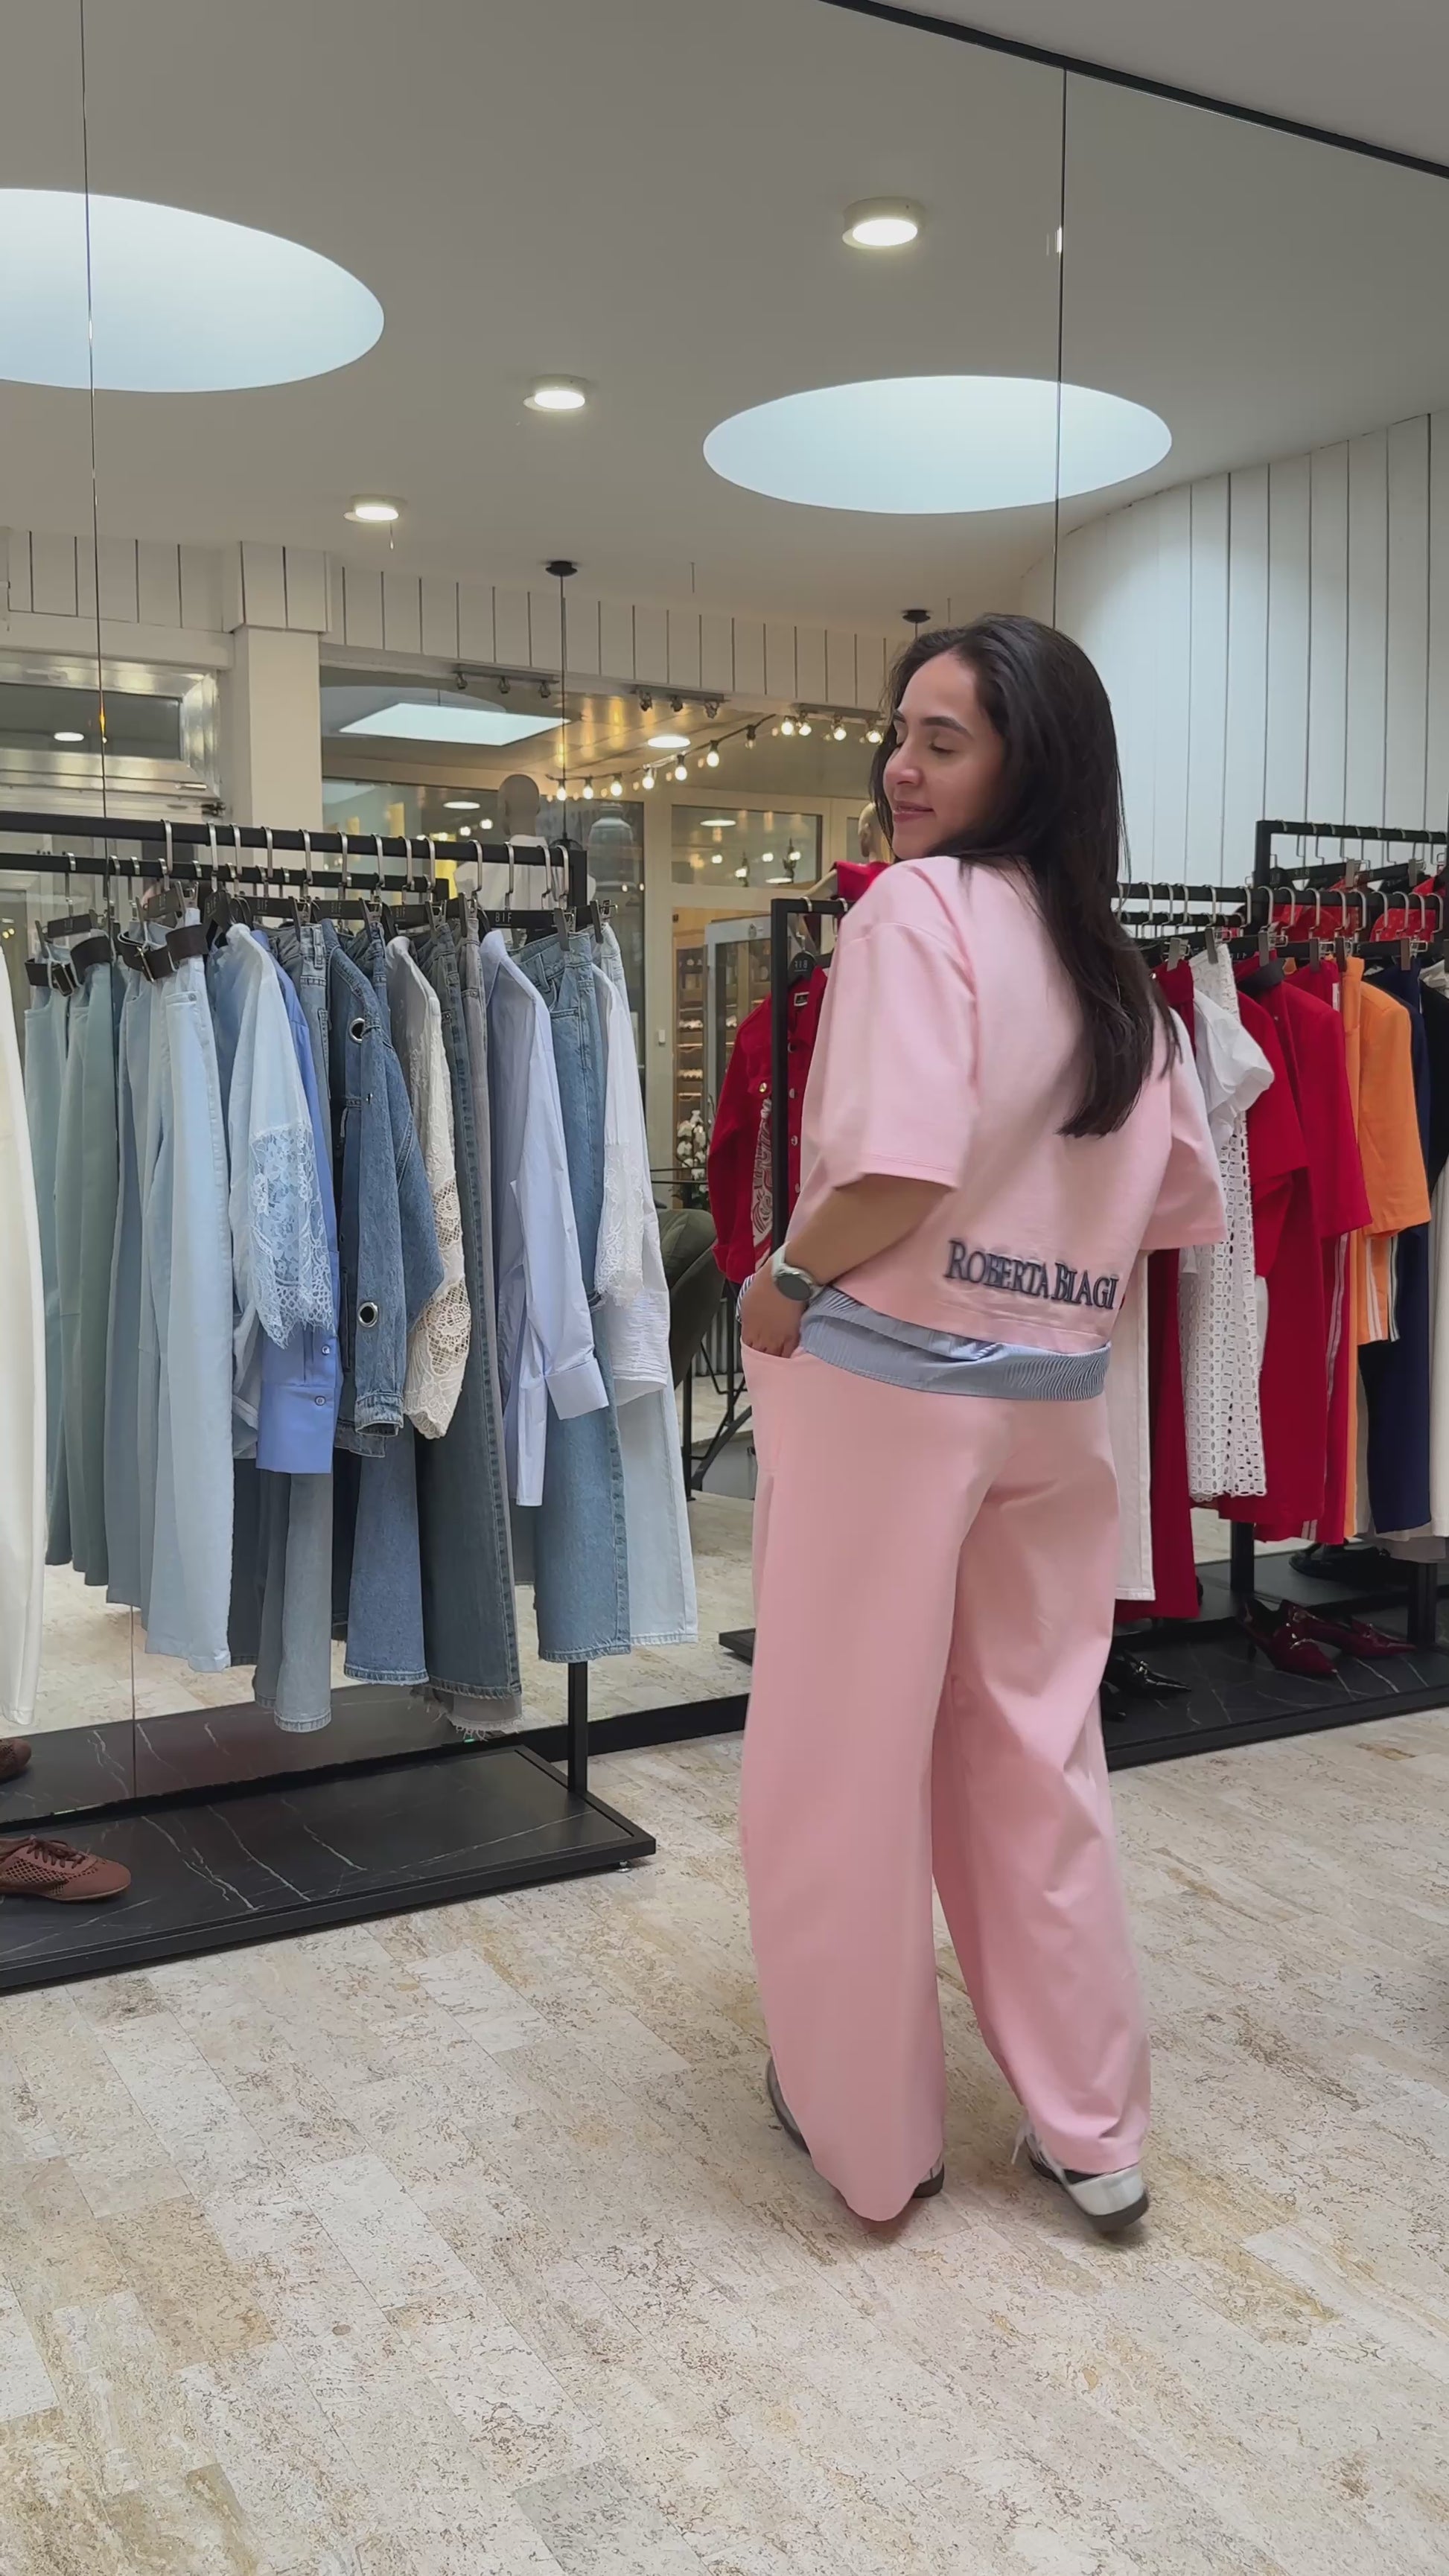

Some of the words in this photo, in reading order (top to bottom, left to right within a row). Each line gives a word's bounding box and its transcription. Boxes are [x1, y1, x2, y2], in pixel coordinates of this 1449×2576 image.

[495, 912, 512, 922] BIF
[943, 1239, 1049, 1299] ROBERTA
[1051, 1262, 1119, 1310] BIAGI
